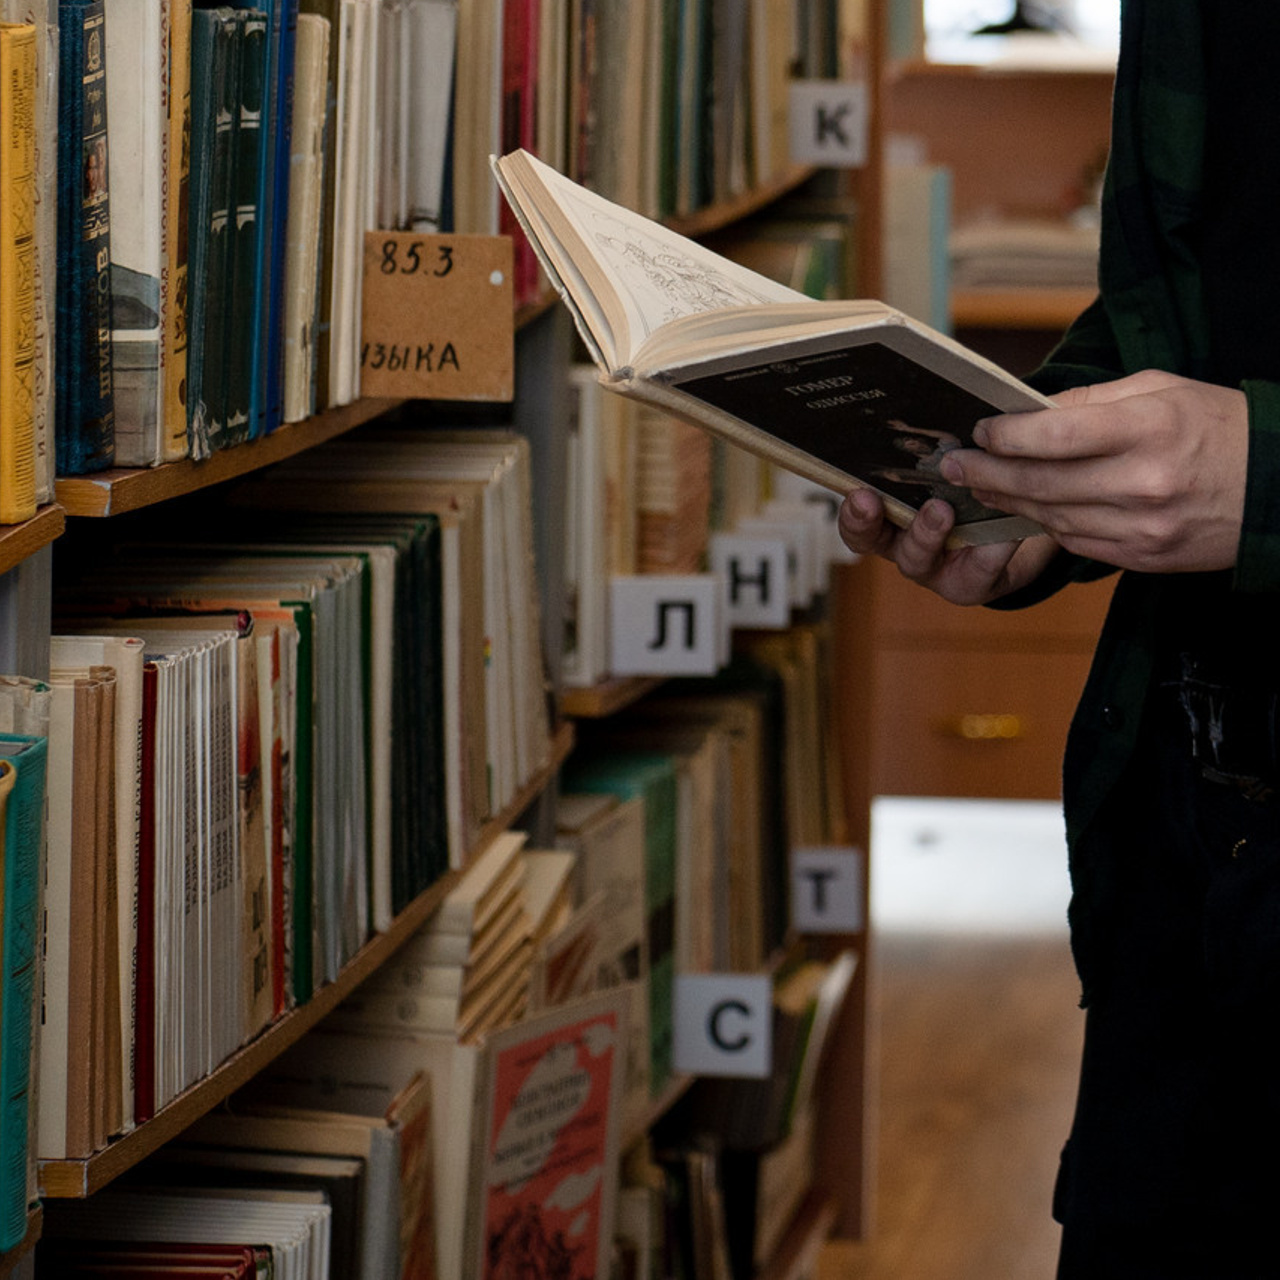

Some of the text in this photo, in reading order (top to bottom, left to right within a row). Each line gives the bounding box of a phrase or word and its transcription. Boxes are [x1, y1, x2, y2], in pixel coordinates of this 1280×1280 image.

[814, 102, 849, 147] К
[380, 240, 453, 277] 85.3
[785, 375, 853, 396] ГОМЕР
[806, 388, 887, 409] ОДИССЕЯ
[727, 556, 769, 609] Н
[648, 599, 697, 652] Л
[799, 867, 842, 915] Т
[705, 998, 752, 1054] С
